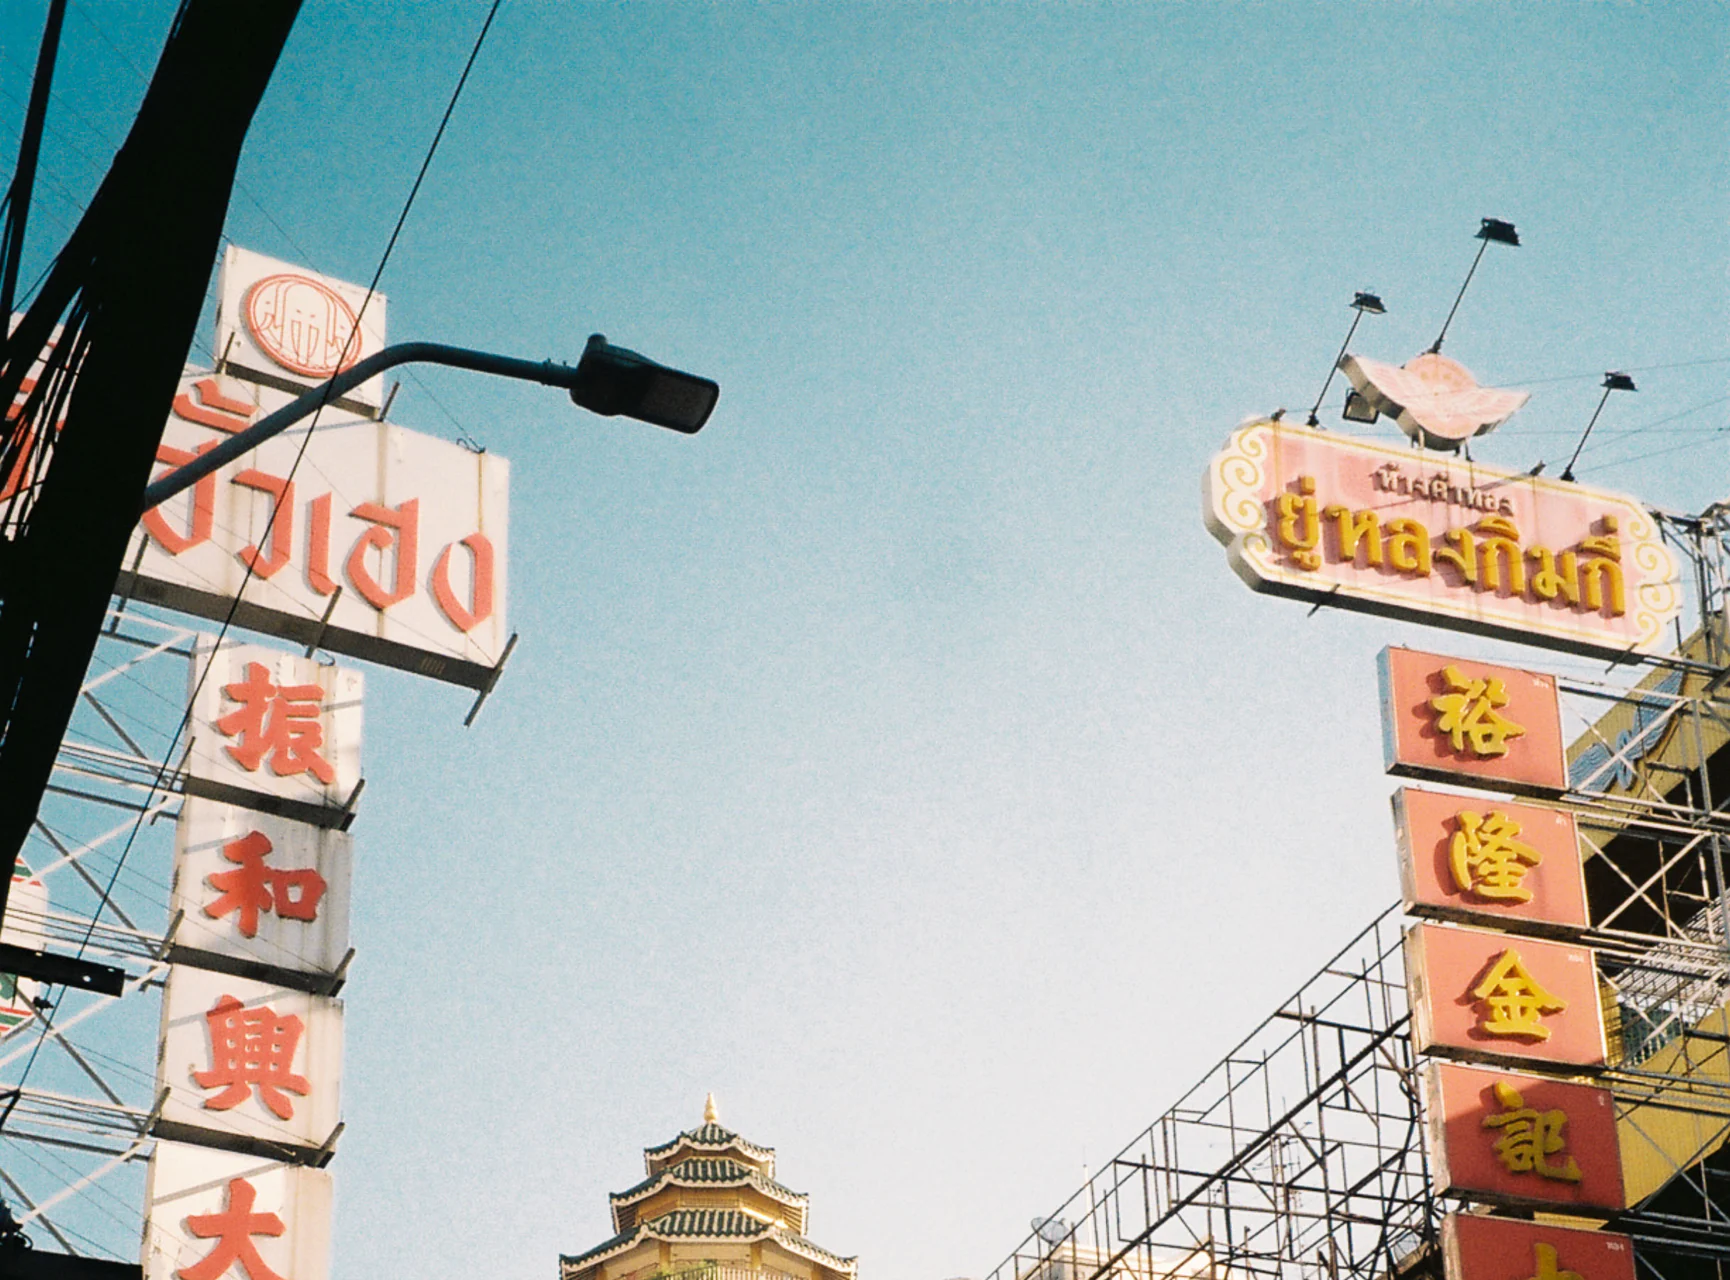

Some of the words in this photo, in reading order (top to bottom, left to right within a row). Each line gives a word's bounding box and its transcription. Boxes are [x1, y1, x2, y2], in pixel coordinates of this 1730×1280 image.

[1275, 475, 1626, 617] ยู่หลงกิมกี่
